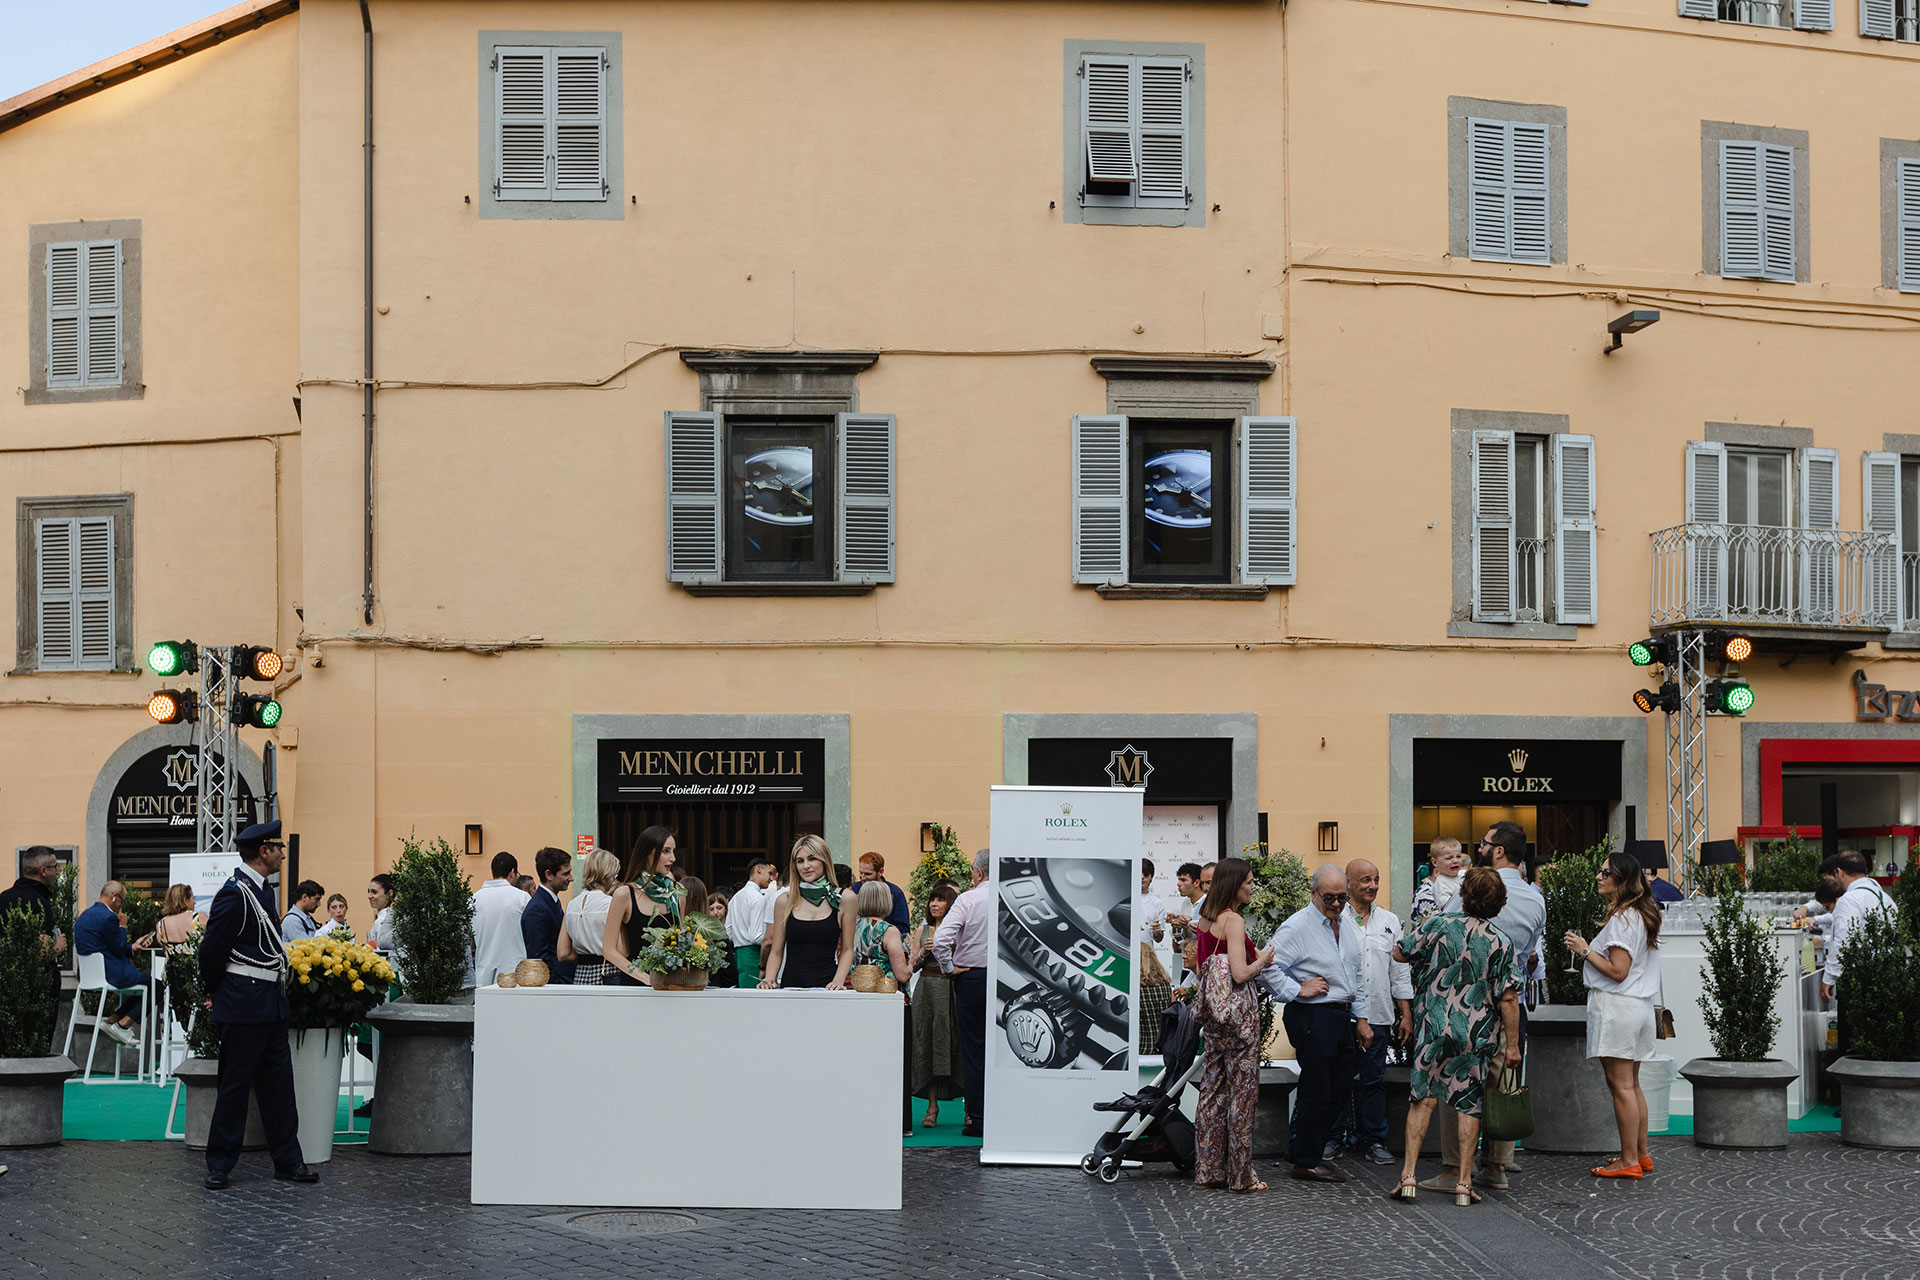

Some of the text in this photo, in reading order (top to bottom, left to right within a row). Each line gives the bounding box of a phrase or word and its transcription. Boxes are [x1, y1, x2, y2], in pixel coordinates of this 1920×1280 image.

[171, 758, 193, 783] M
[618, 750, 804, 776] MENICHELLI
[1115, 755, 1144, 783] M
[666, 783, 756, 795] Gioiellieri dal 1912
[1482, 777, 1554, 792] ROLEX
[169, 815, 196, 826] Home
[1045, 817, 1088, 828] ROLEX
[1064, 938, 1117, 978] 18
